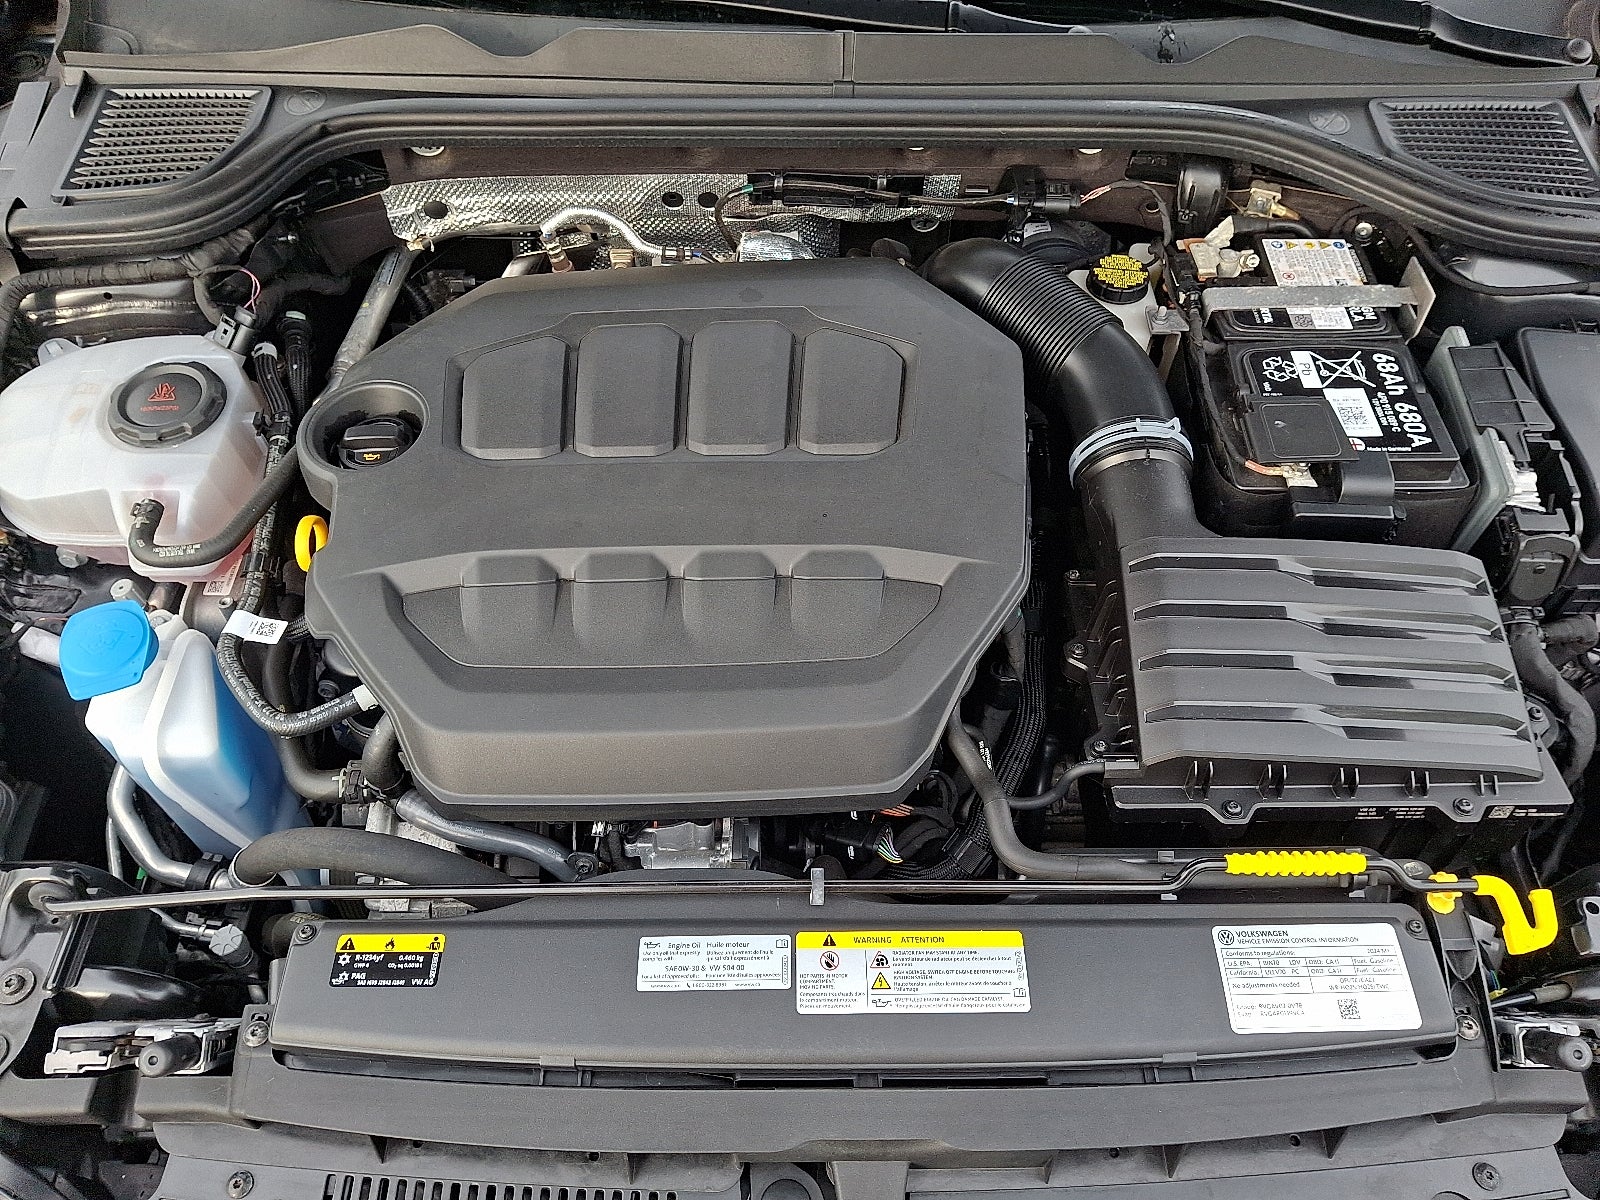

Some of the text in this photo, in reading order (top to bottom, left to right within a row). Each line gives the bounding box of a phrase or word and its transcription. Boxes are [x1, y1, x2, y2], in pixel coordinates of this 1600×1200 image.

[1361, 306, 1378, 321] GM
[1372, 353, 1409, 396] 68Ah
[1394, 402, 1433, 448] 680A
[1235, 930, 1289, 938] VOLKSWAGEN
[901, 936, 945, 944] ATTENTION
